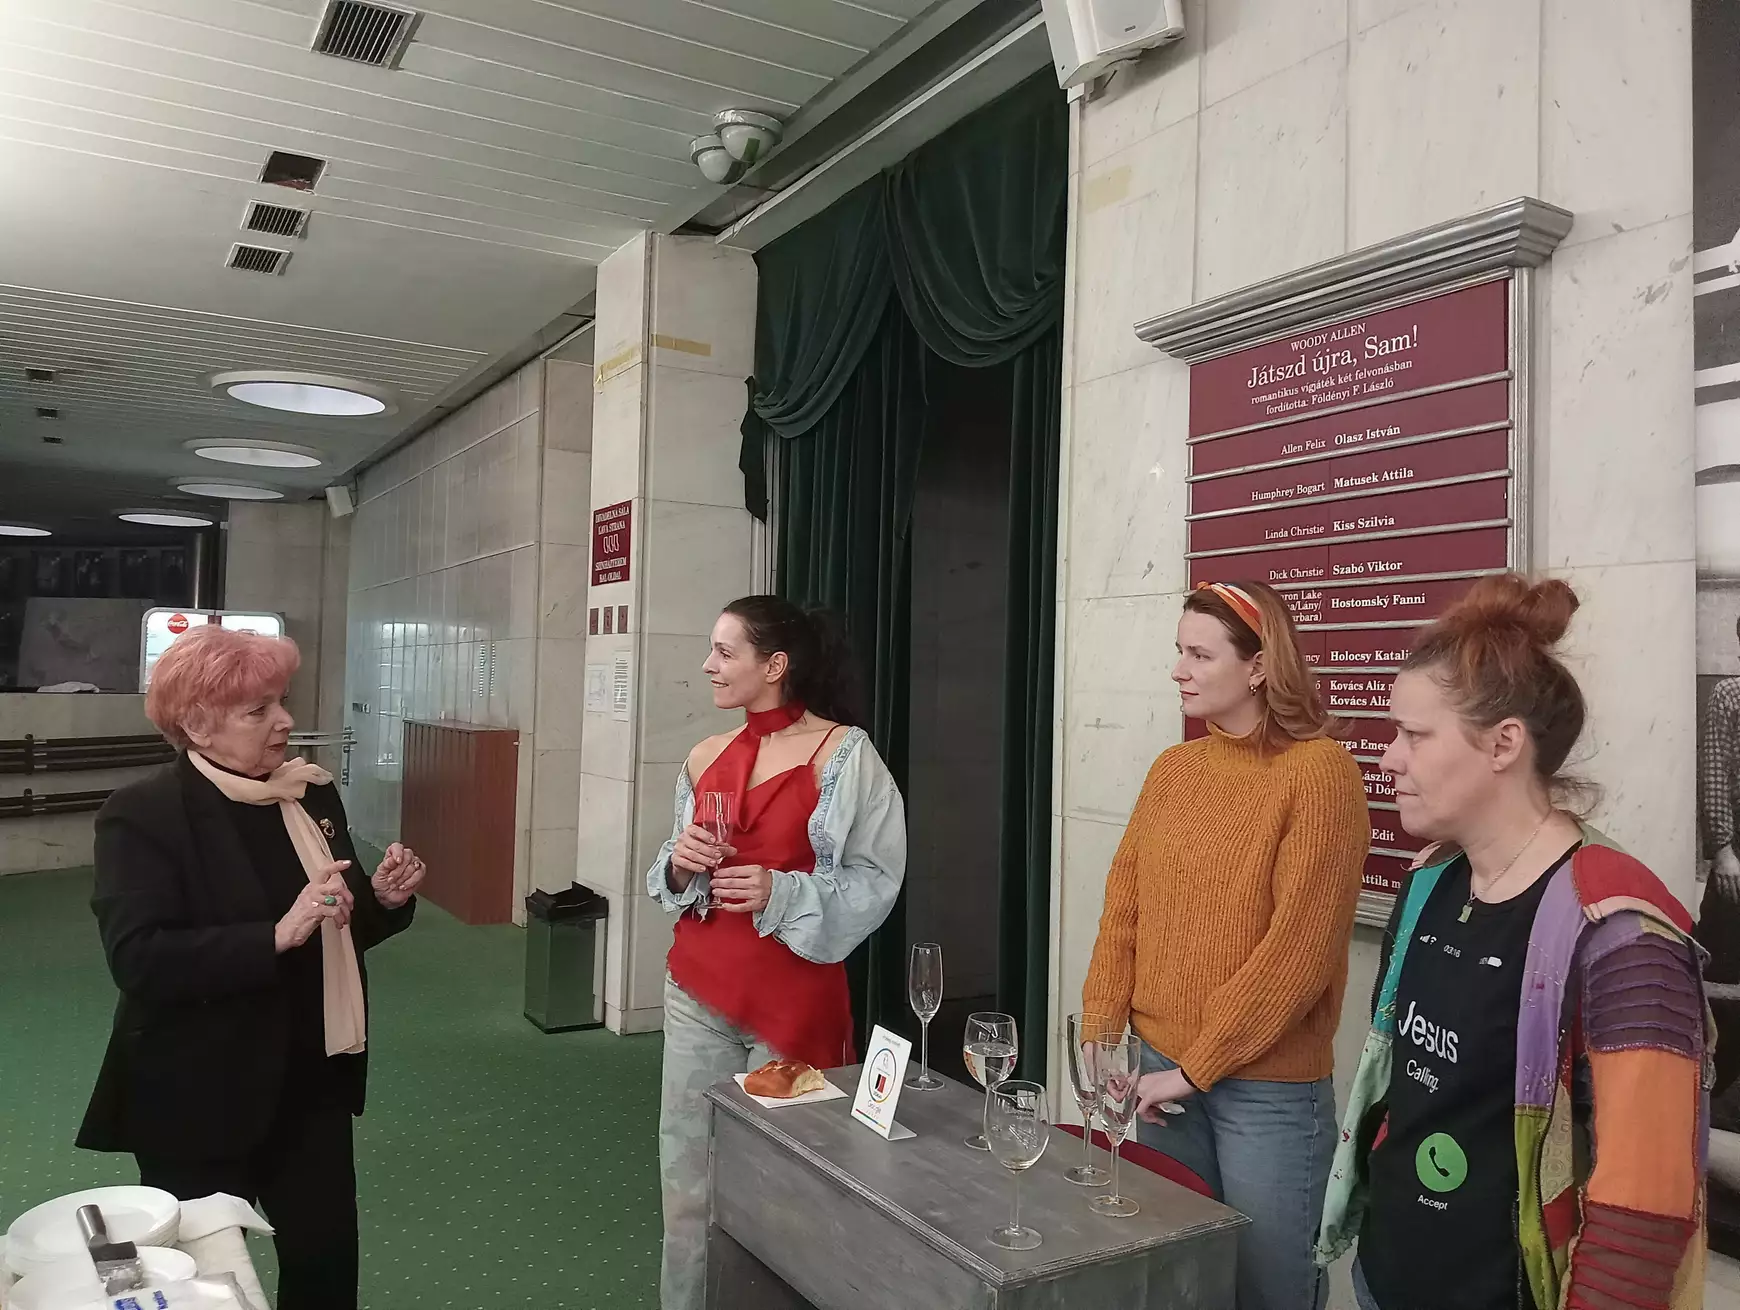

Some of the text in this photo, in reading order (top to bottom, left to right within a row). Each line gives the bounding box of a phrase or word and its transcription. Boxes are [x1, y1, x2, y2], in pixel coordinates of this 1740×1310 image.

[1291, 323, 1366, 352] WOODY ALLEN
[1247, 324, 1418, 388] Játszd újra, Sam!
[1251, 360, 1413, 405] romantikus vígjáték két felvonásban
[1266, 377, 1394, 415] fordította: Földényi F. László
[1281, 425, 1401, 455] Allen Felix Olasz István
[1251, 467, 1414, 501] Humphrey Bogart Matusek Attila
[1265, 515, 1395, 540] Linda Christie Kiss Szilvia
[1269, 560, 1403, 580] Dick Christie Szabó Viktor
[1301, 590, 1322, 600] Lake
[1331, 592, 1426, 609] Hostomský Fanni
[1330, 650, 1372, 663] Holocsy
[1375, 649, 1412, 661] Katali
[1330, 680, 1364, 691] Kovács
[1365, 680, 1386, 691] Alíz
[1330, 695, 1367, 706] Kovács
[1369, 695, 1391, 707] Alíz
[1360, 739, 1391, 751] Emes
[1376, 783, 1399, 796] Dór
[1372, 828, 1395, 841] Edit
[1398, 1000, 1459, 1064] Jesus
[1417, 1194, 1448, 1211] Accept
